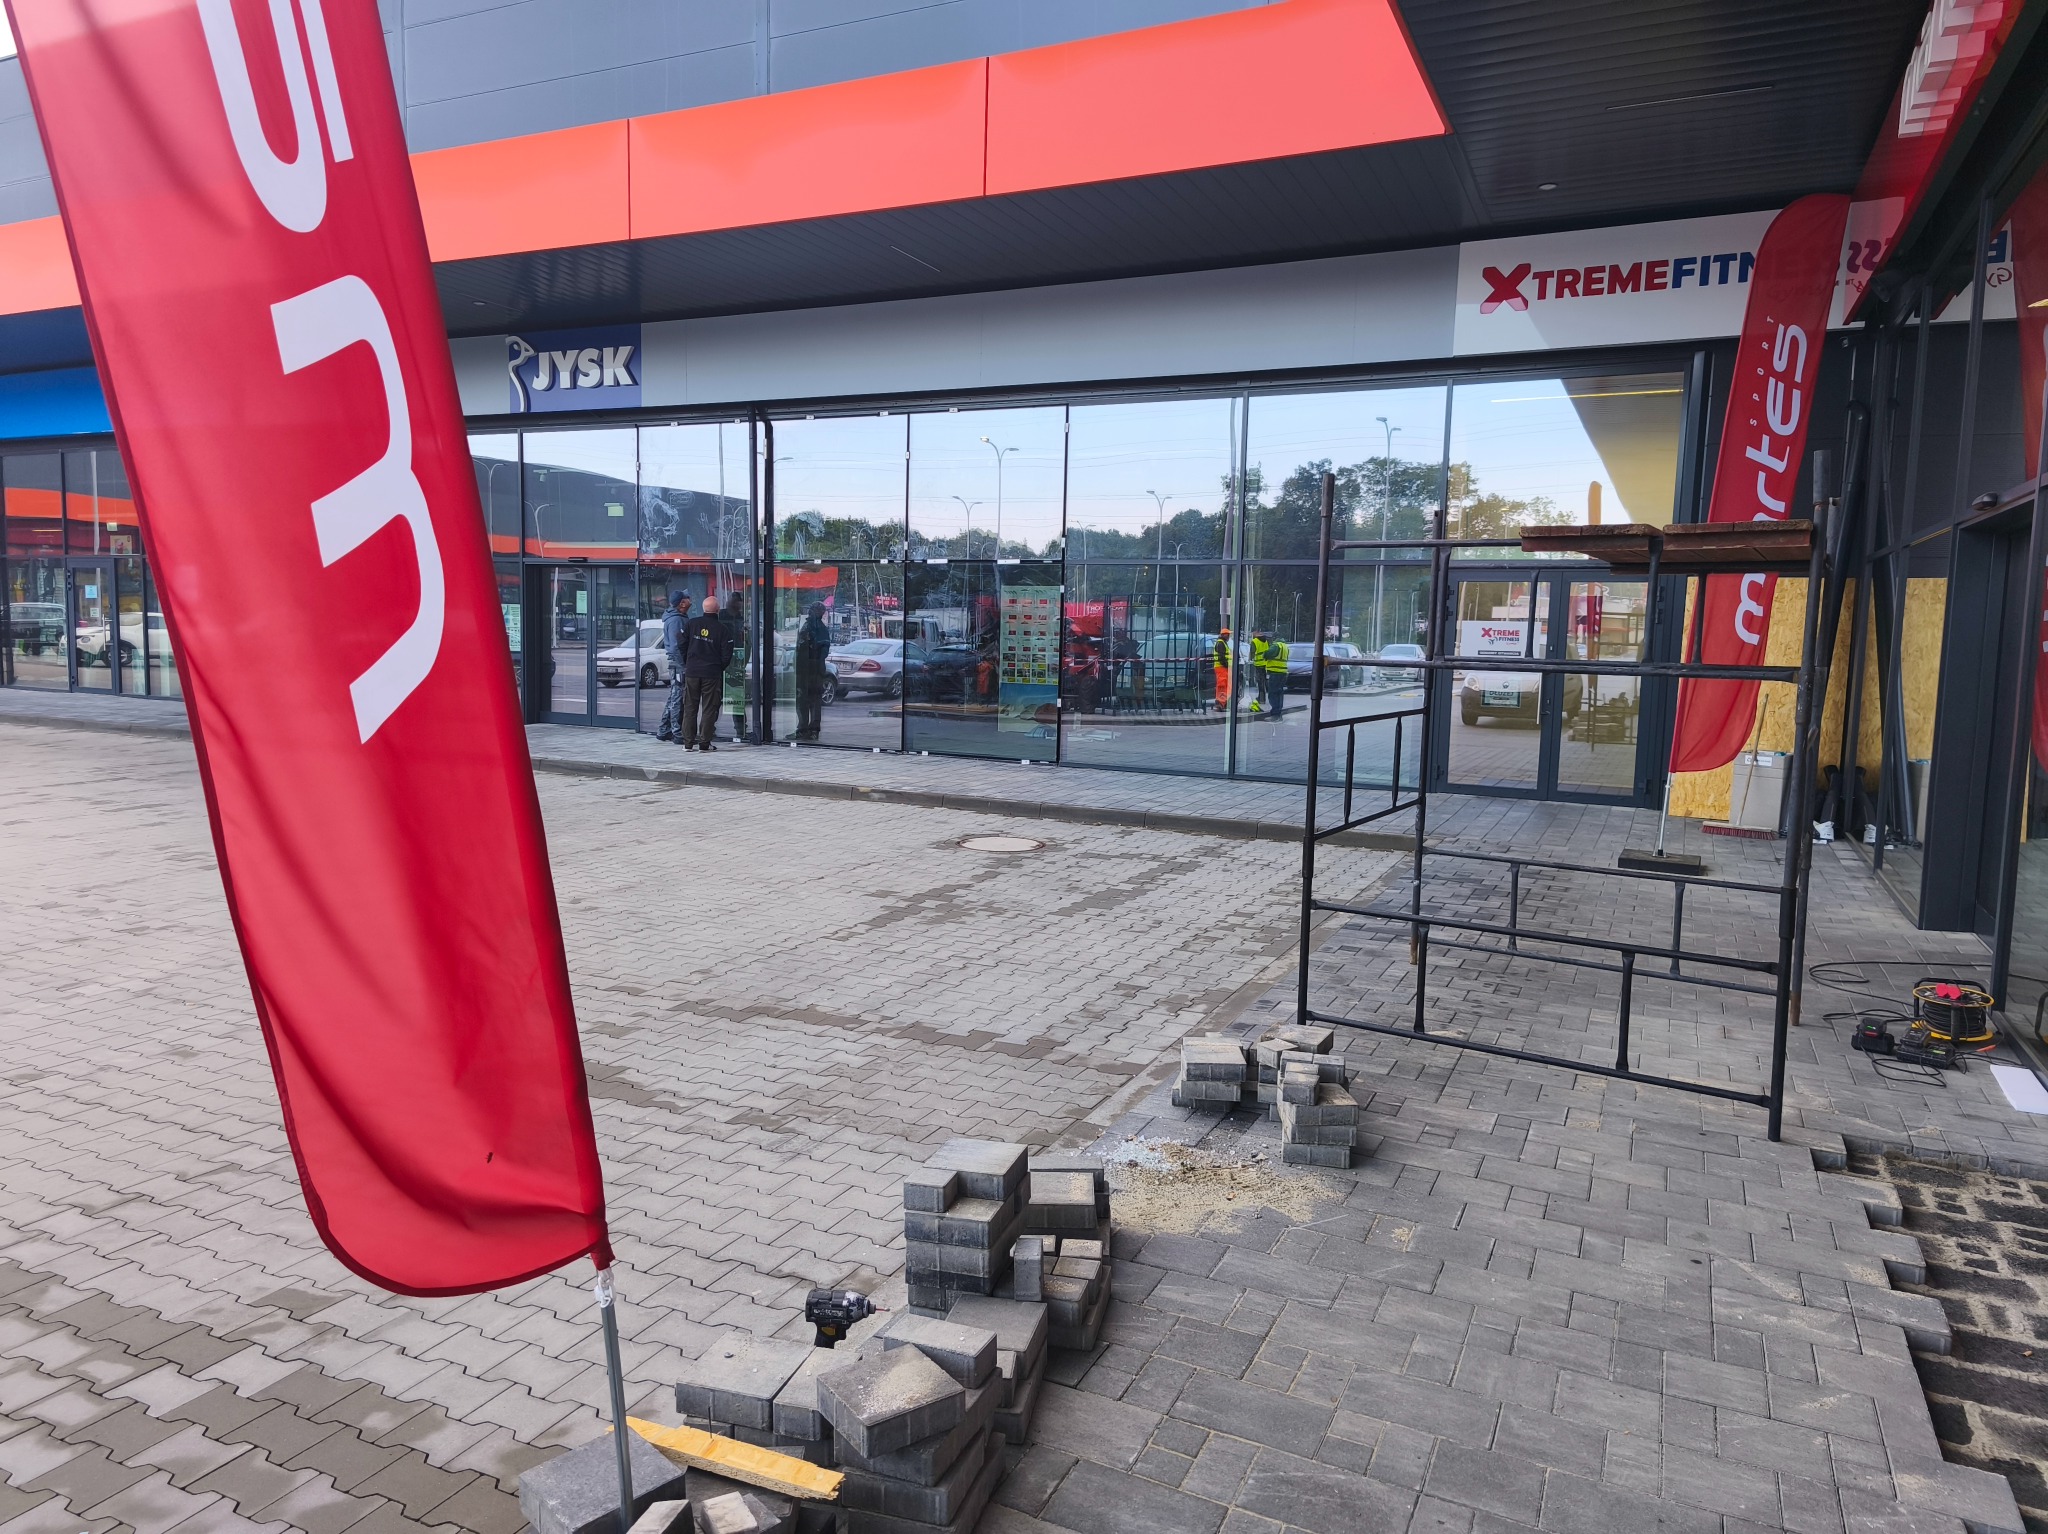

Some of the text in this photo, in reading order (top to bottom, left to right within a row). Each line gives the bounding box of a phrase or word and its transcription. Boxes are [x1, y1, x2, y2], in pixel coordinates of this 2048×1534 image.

[532, 345, 639, 392] JYSK
[1734, 322, 1808, 646] mrtes
[1481, 627, 1520, 637] XTREME
